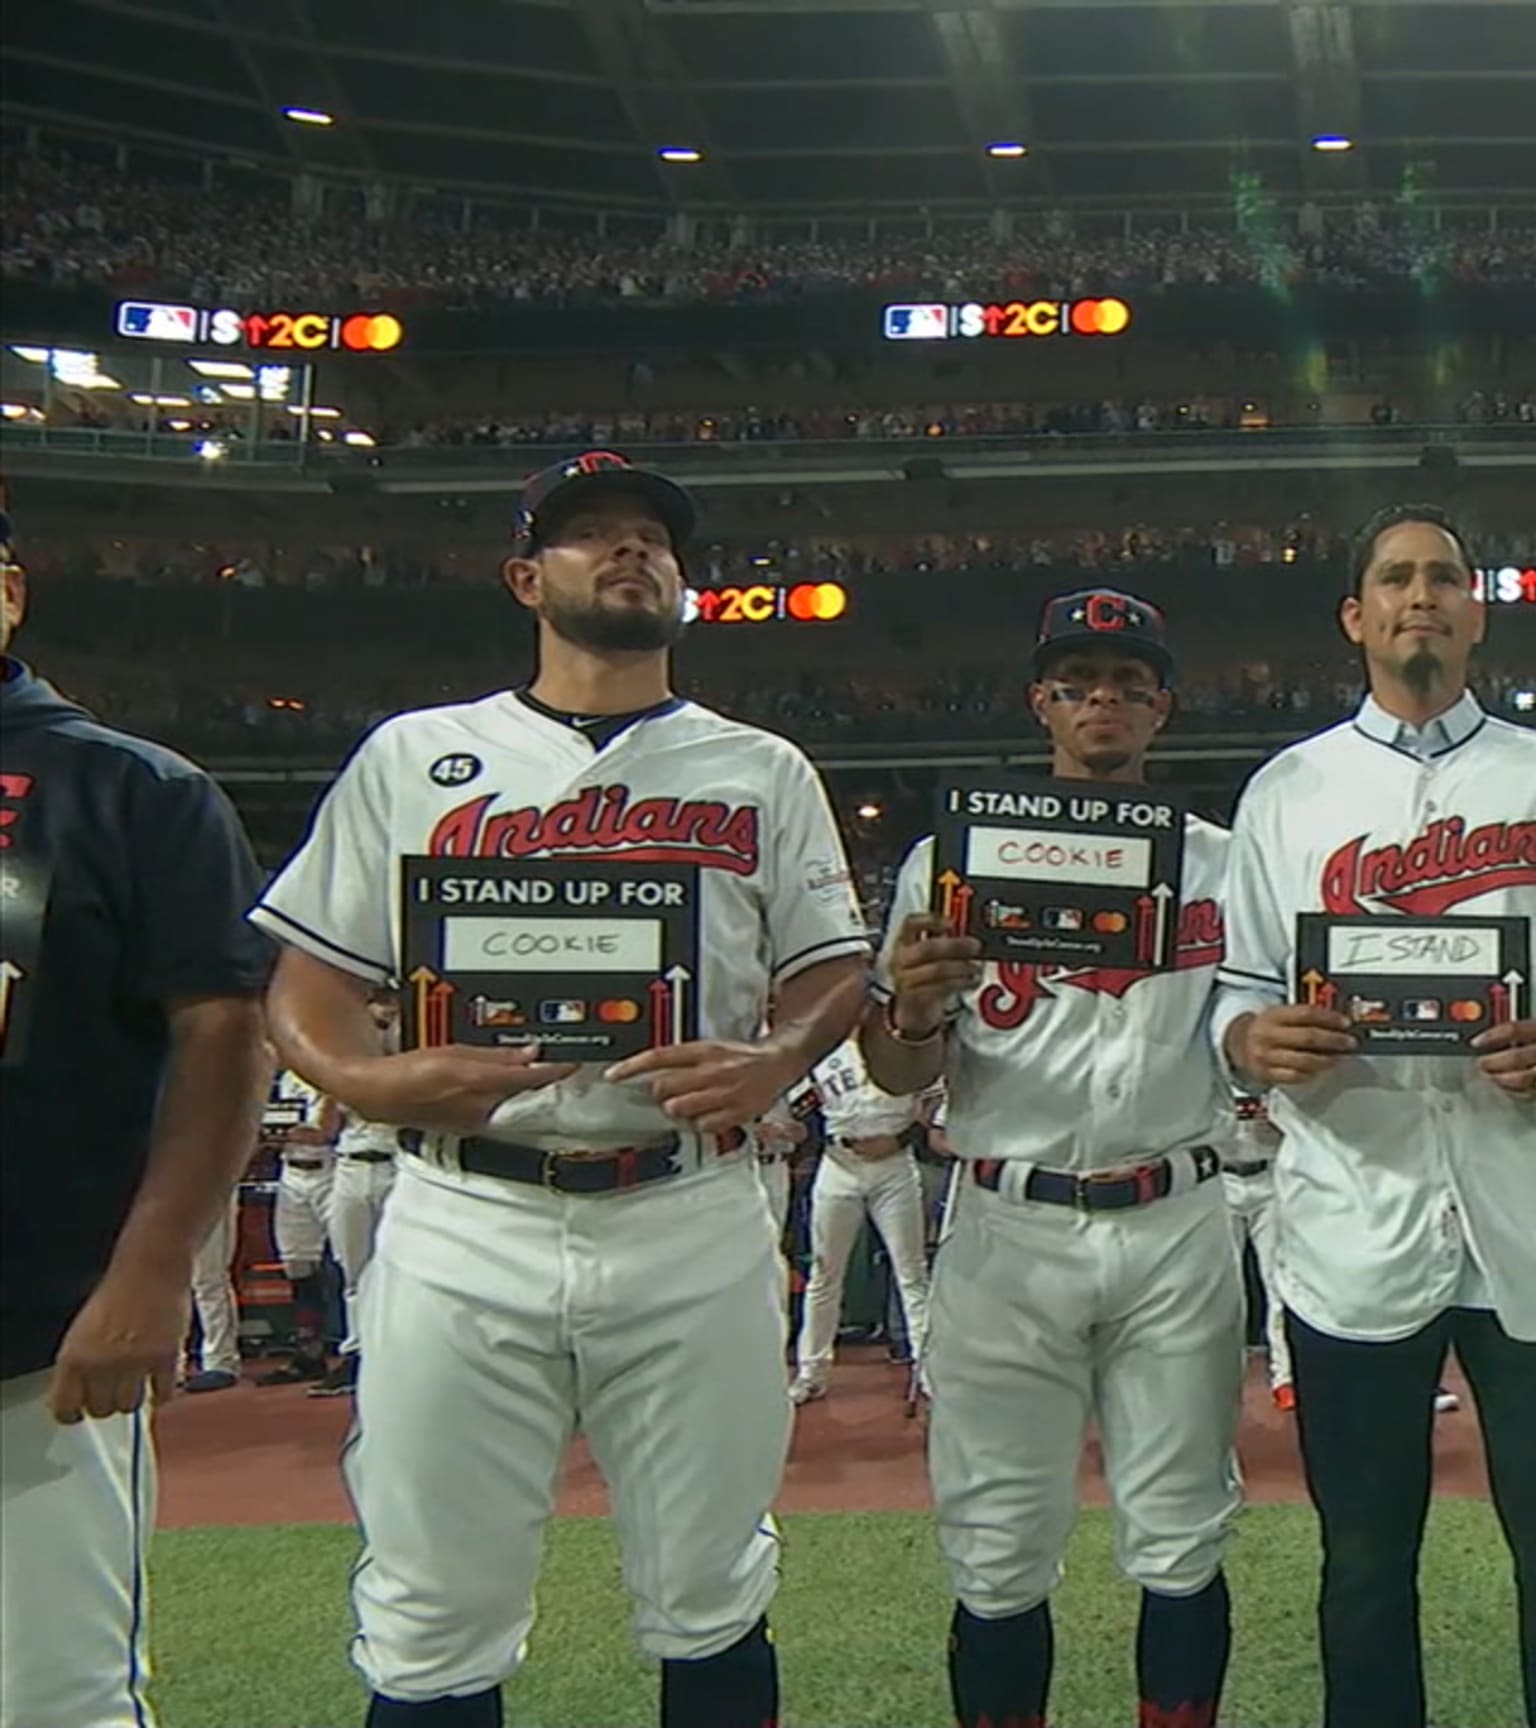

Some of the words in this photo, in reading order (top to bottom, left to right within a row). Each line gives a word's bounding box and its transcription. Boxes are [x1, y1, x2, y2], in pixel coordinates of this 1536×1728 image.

[433, 758, 474, 781] 45
[968, 791, 1061, 818] STAND
[1070, 799, 1109, 822] UP
[1117, 803, 1172, 827] FOR
[430, 784, 759, 875] Indians
[998, 841, 1124, 868] COOKIE
[419, 878, 429, 901] I
[441, 878, 556, 903] STAND
[565, 882, 610, 904] UP
[620, 882, 684, 906] FOR
[481, 932, 620, 956] COOKIE
[1339, 933, 1383, 968] I
[1386, 934, 1481, 963] STAND
